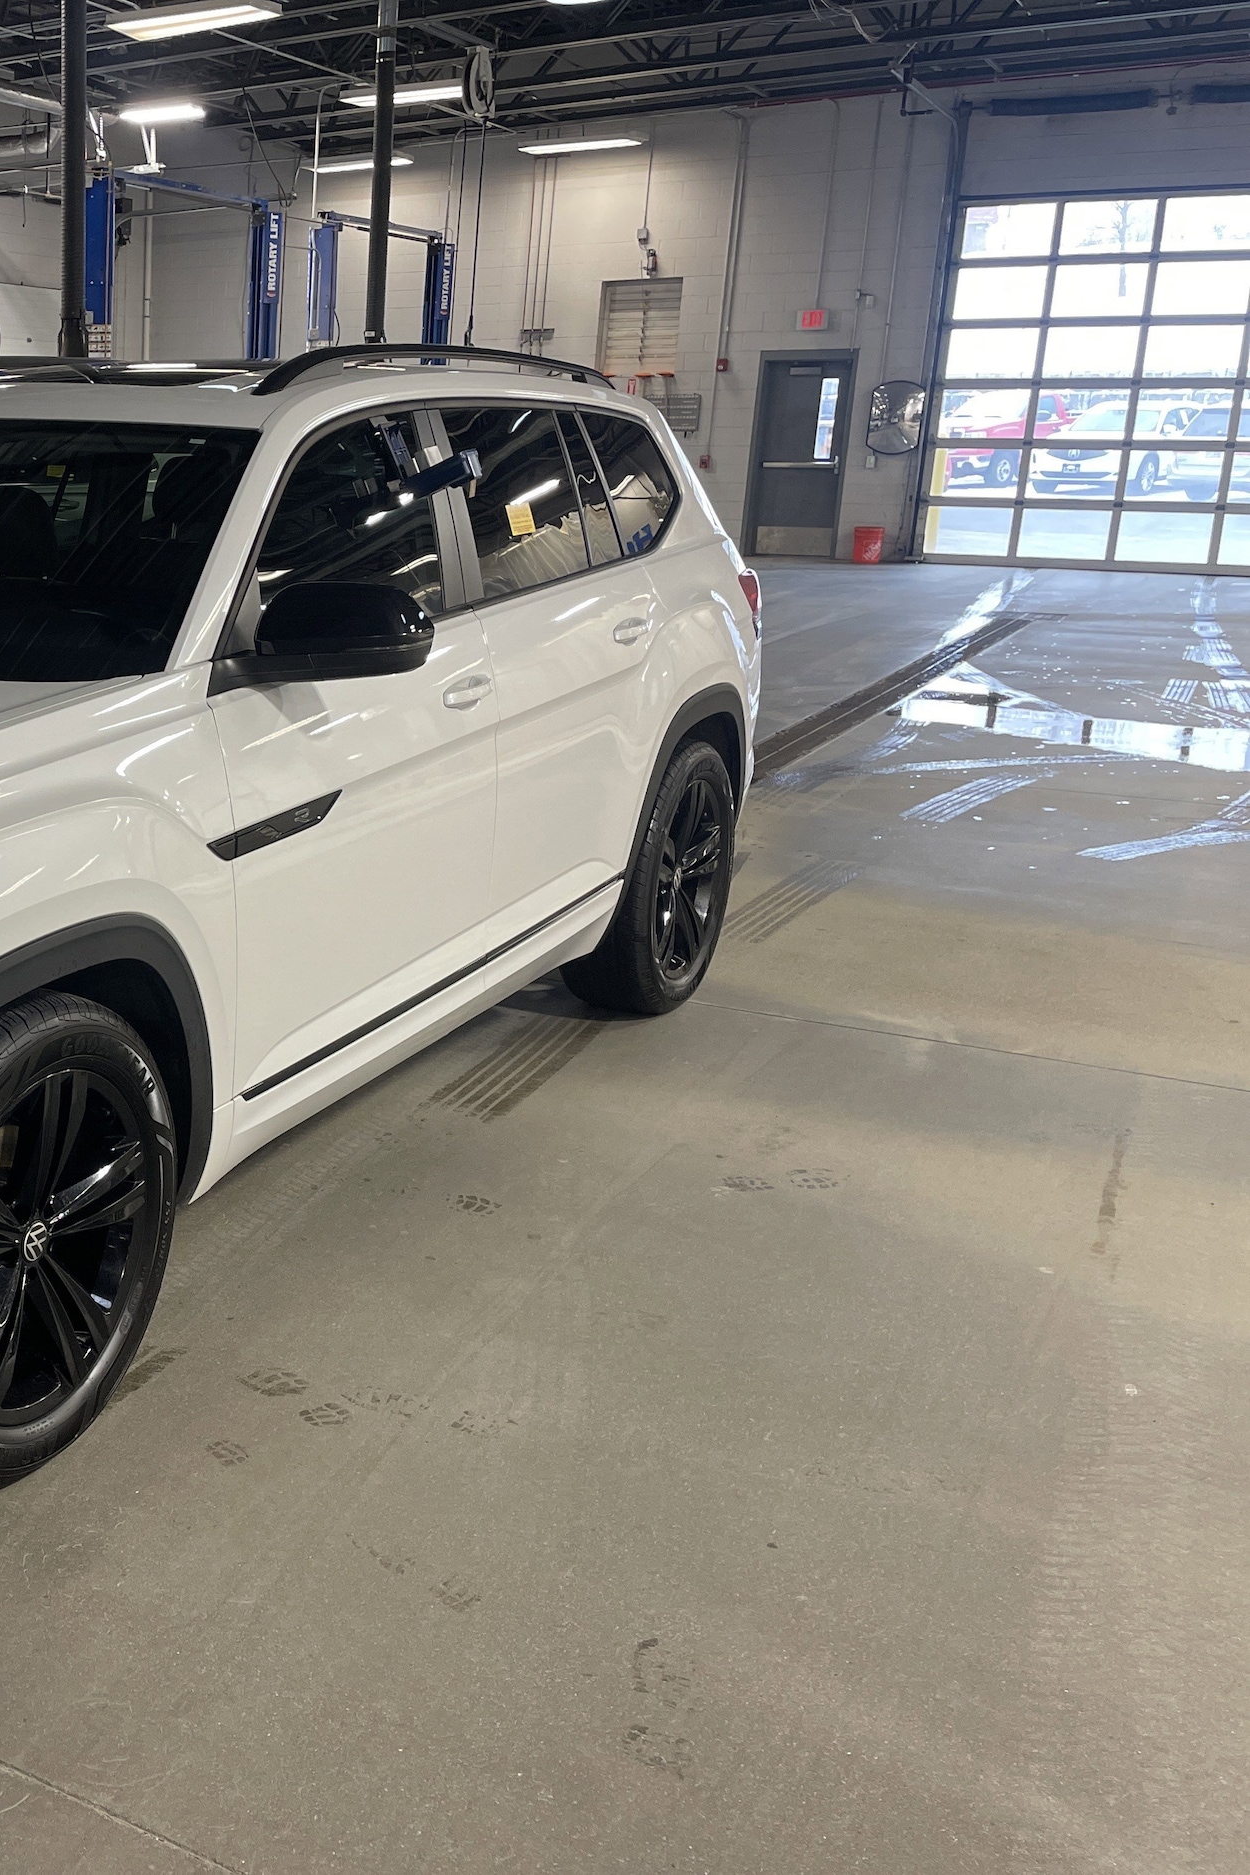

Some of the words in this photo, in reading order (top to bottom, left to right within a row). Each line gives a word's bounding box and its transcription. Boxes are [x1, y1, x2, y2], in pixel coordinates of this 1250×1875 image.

[270, 212, 279, 240] LIFT
[267, 241, 278, 291] ROTARY
[444, 244, 452, 267] LIFT
[441, 268, 451, 310] ROTARY
